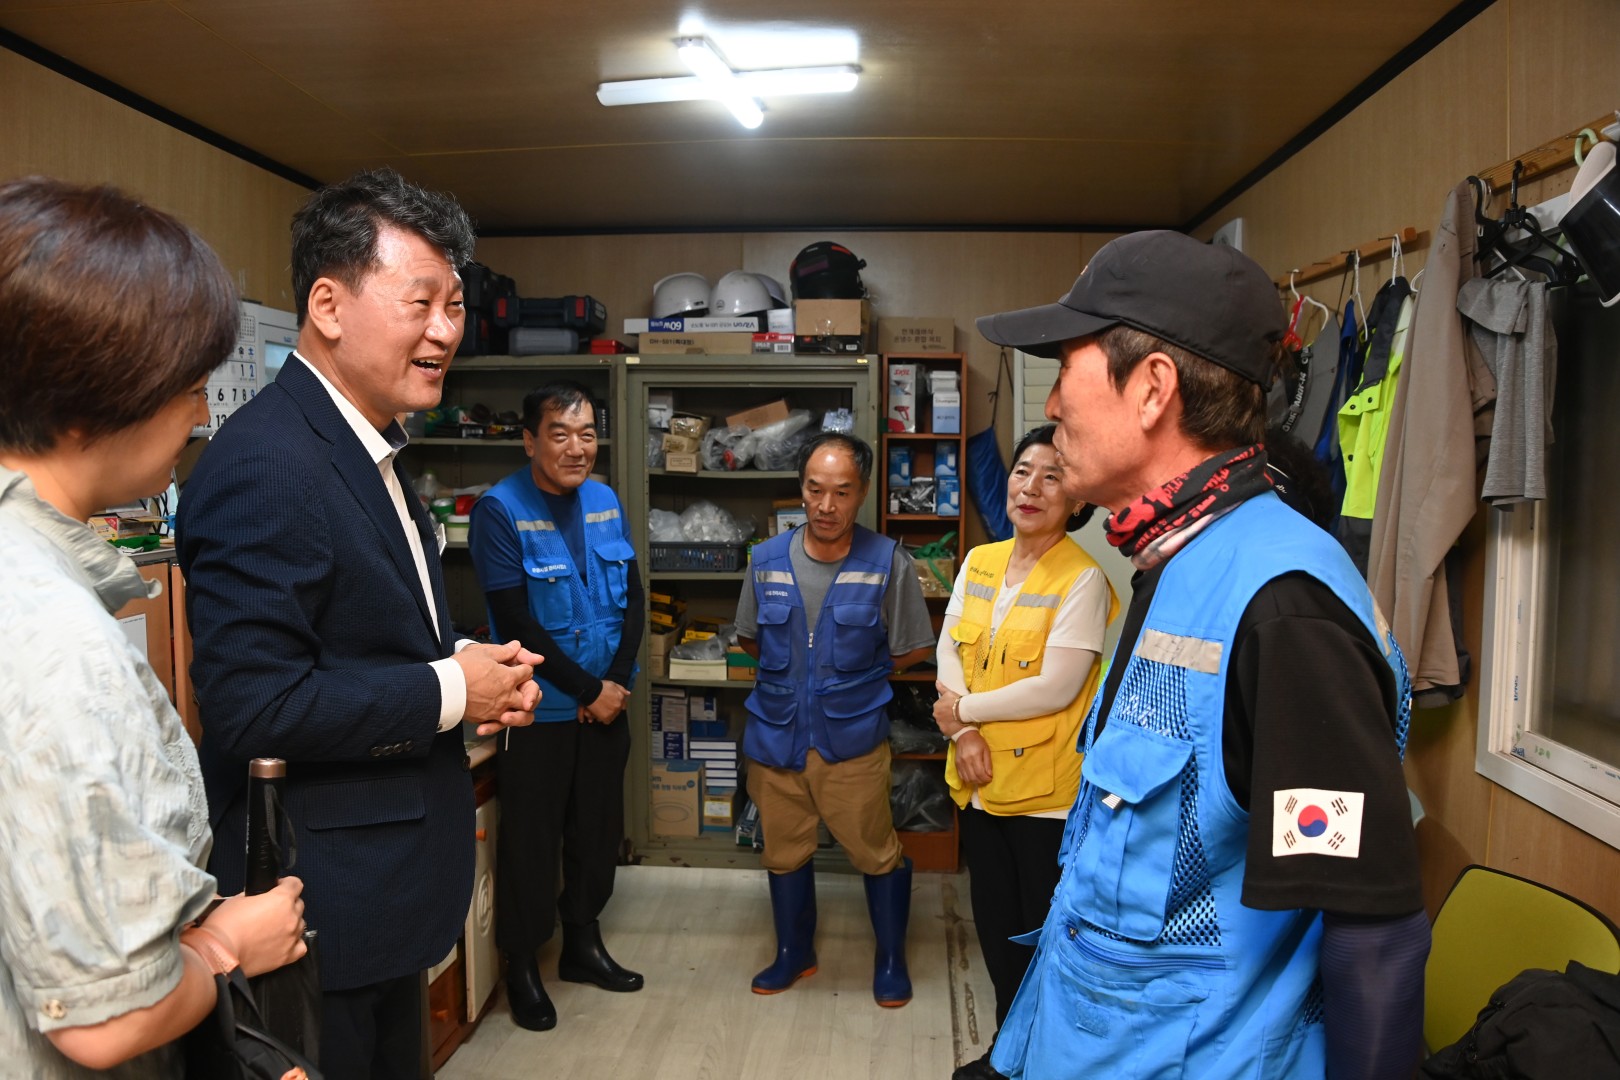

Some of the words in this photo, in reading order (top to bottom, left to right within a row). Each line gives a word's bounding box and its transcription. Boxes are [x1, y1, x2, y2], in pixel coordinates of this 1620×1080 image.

[240, 364, 244, 376] 1
[250, 364, 254, 377] 2
[217, 388, 224, 401] 6
[232, 388, 237, 401] 7
[242, 388, 246, 401] 8
[216, 414, 226, 428] 13
